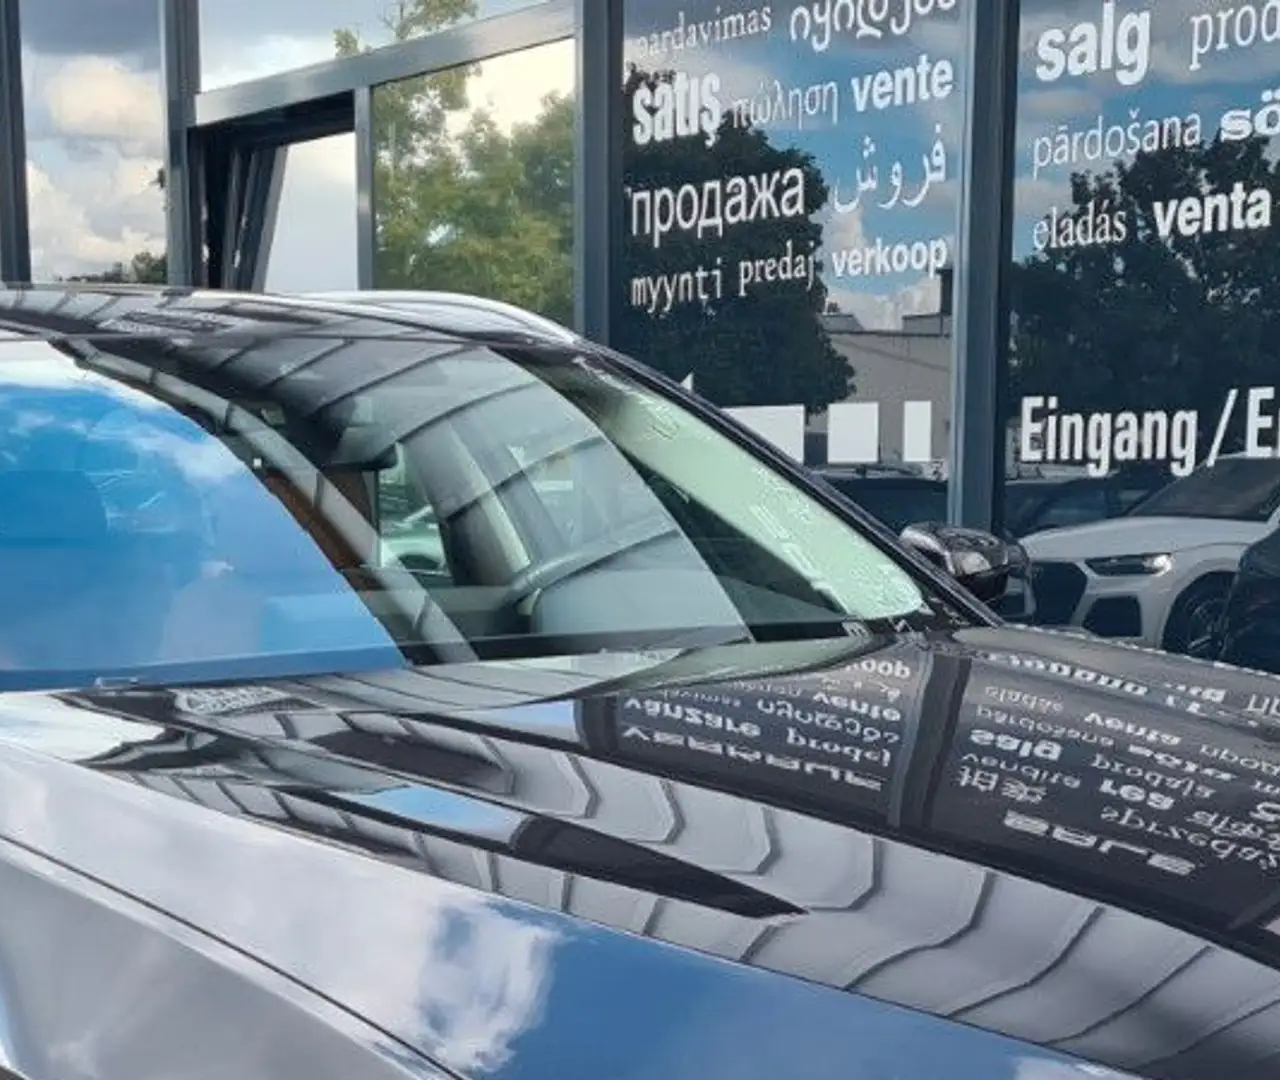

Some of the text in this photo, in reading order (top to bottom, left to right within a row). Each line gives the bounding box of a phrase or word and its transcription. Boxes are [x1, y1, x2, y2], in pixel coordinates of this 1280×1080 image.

[1036, 0, 1150, 86] salg
[632, 71, 721, 148] satış
[851, 54, 954, 113] vente
[1032, 107, 1201, 181] pārdošana
[630, 167, 805, 249] продажа
[1032, 199, 1127, 251] eladás
[1153, 181, 1272, 238] venta
[738, 240, 816, 297] predaj
[831, 235, 949, 279] verkoop
[1020, 396, 1198, 478] Eingang
